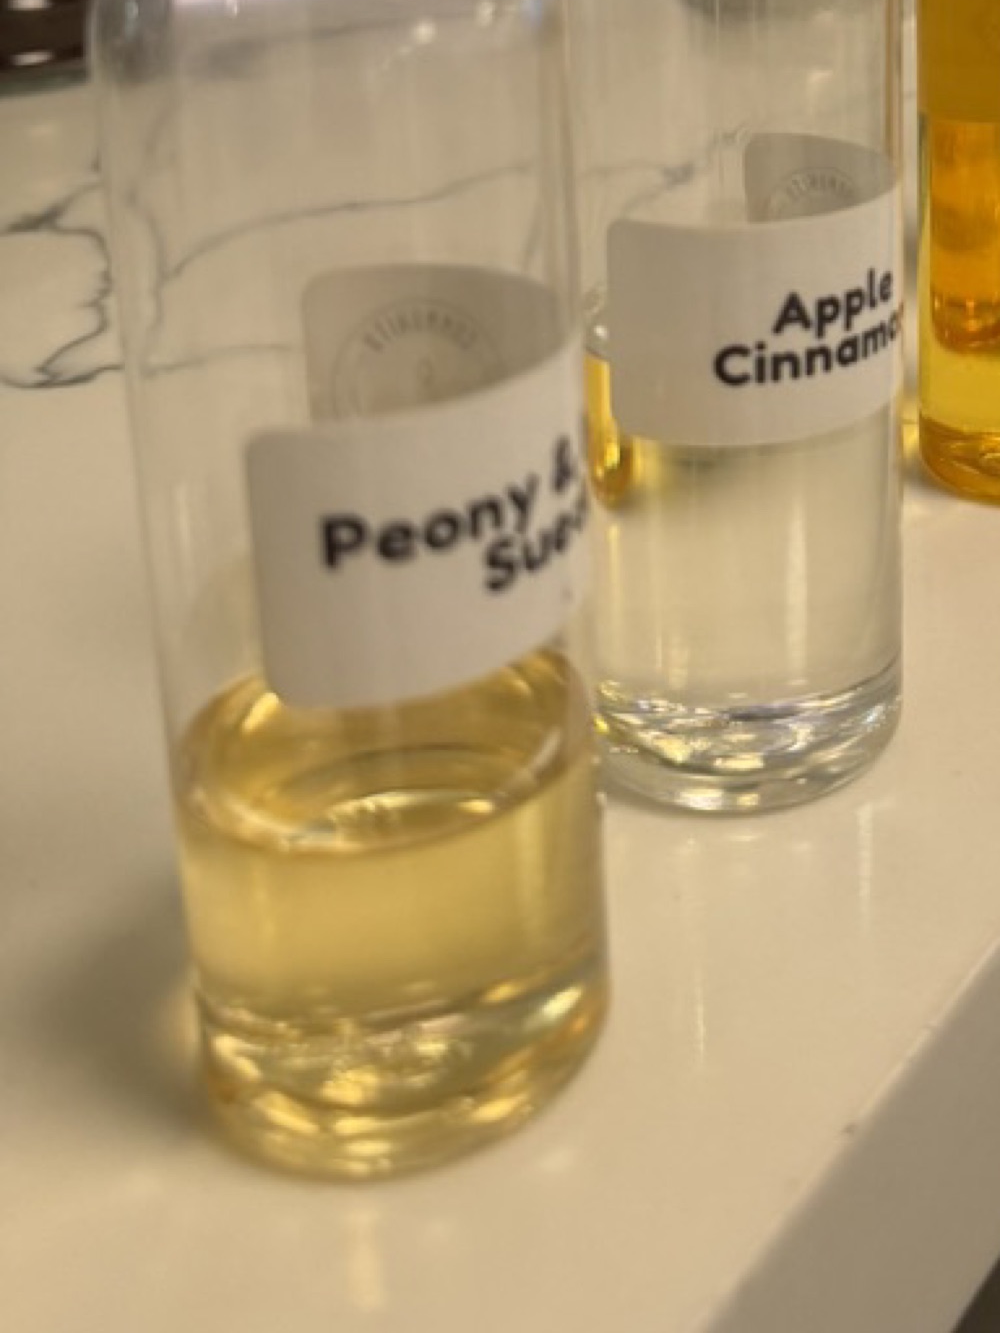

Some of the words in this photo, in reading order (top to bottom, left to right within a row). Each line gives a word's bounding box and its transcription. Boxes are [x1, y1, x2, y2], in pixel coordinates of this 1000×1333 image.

[712, 301, 904, 388] Cinnamo
[771, 266, 894, 340] Apple
[319, 472, 540, 572] Peony
